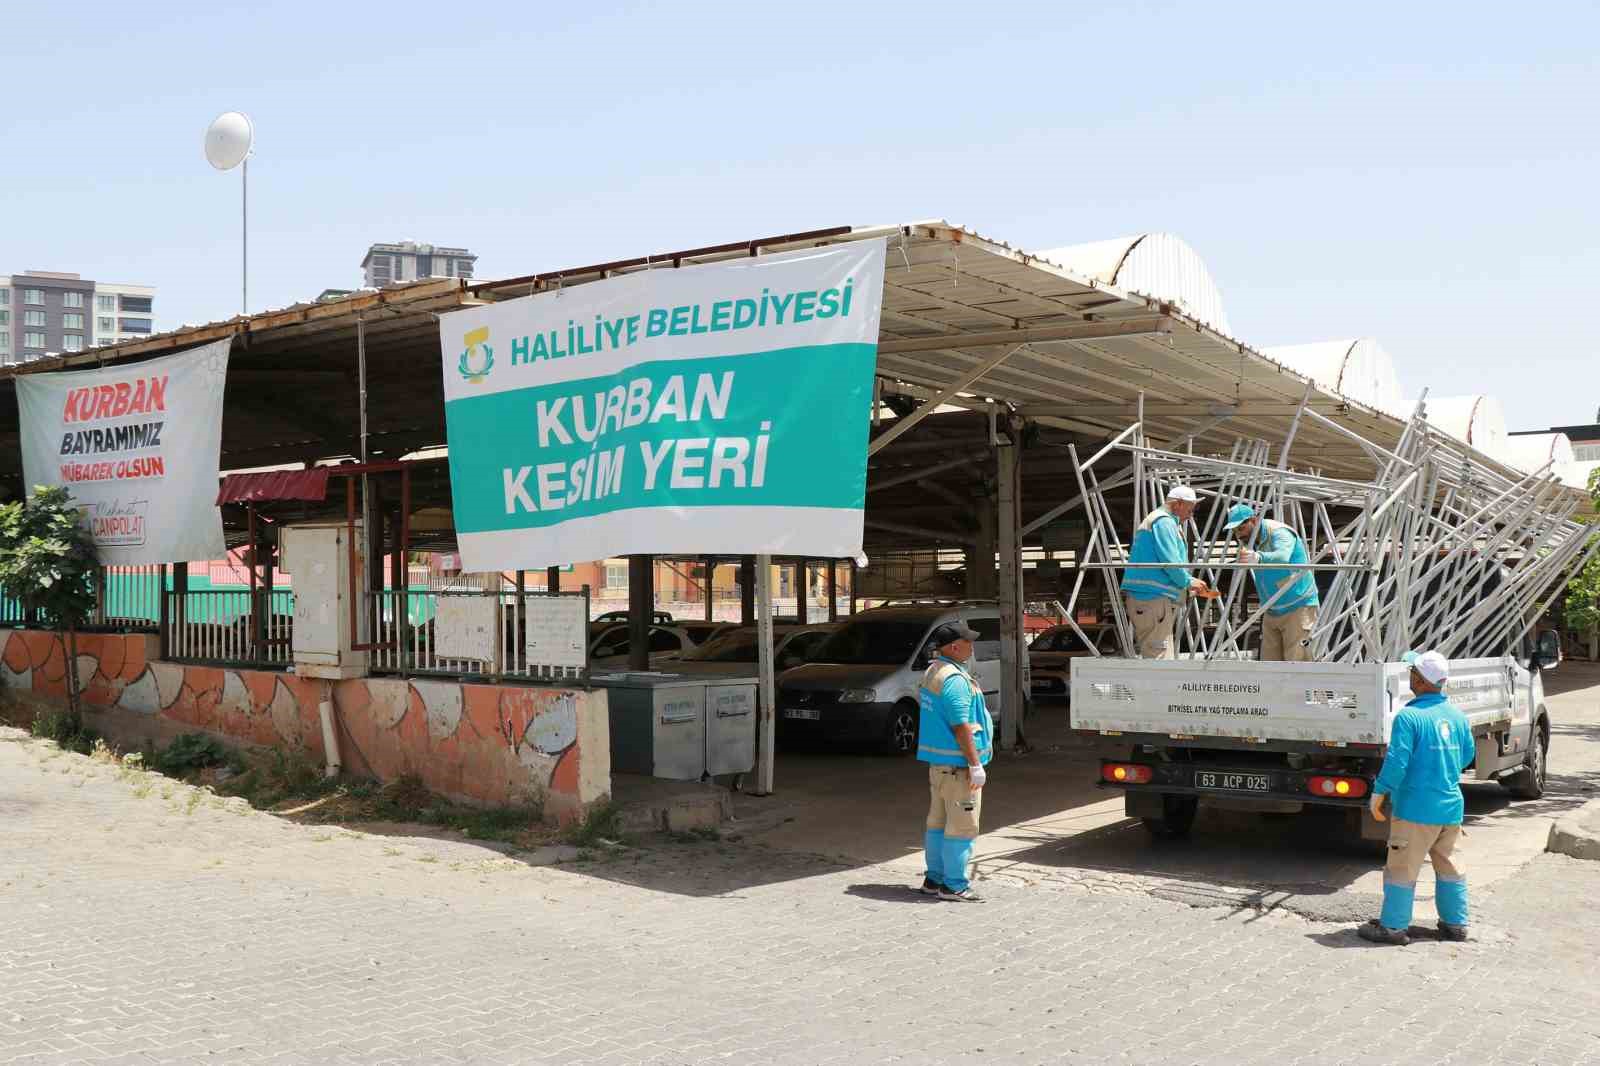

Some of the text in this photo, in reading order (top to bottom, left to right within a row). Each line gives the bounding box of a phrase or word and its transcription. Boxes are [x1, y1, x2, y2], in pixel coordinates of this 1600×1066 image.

[511, 277, 853, 366] HALİLİYE BELEDİYESİ
[64, 375, 168, 422] KURBAN
[536, 371, 735, 447] KURBAN
[60, 421, 163, 455] BAYRAMIMIZ
[116, 457, 163, 478] OLSUN
[503, 421, 771, 514] KESİM YERİ
[1202, 774, 1267, 789] 63 ACP 025
